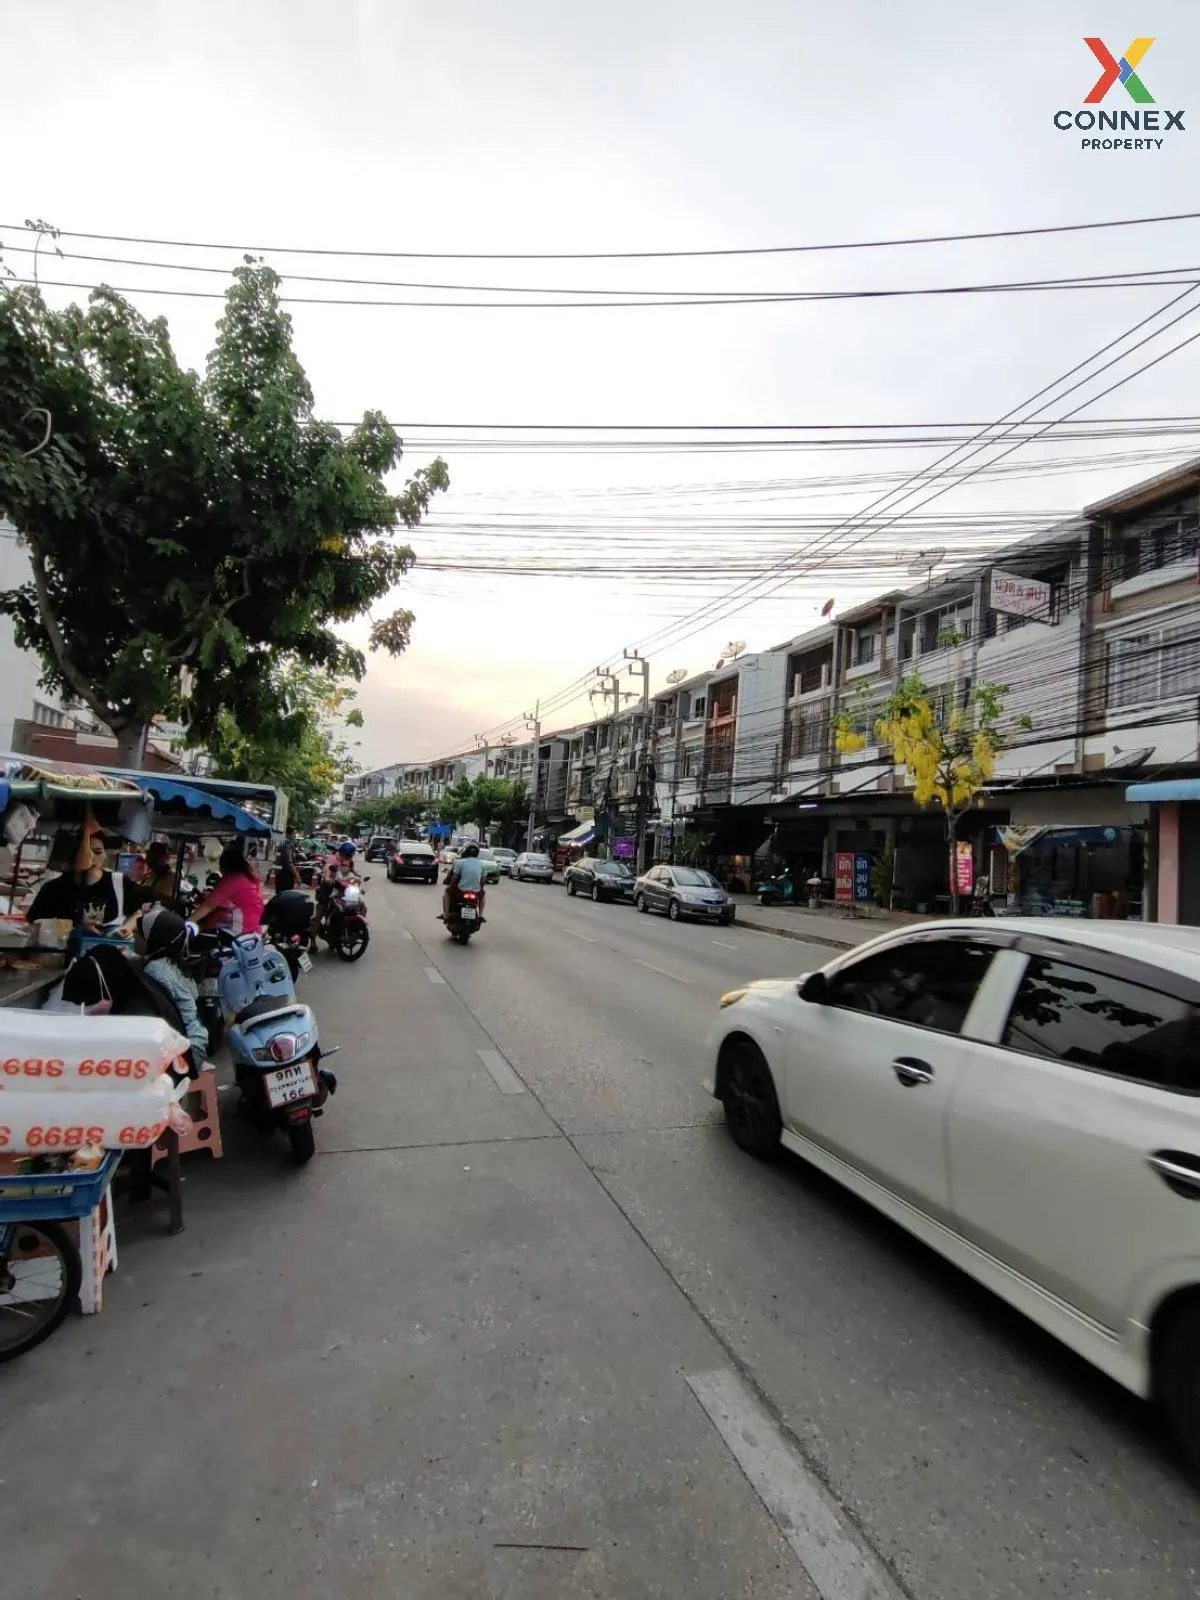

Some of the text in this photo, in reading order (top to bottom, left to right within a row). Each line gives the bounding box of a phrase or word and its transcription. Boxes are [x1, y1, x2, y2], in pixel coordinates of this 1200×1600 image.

[0, 1058, 149, 1080] SB99 SB9
[26, 1126, 104, 1147] SB99
